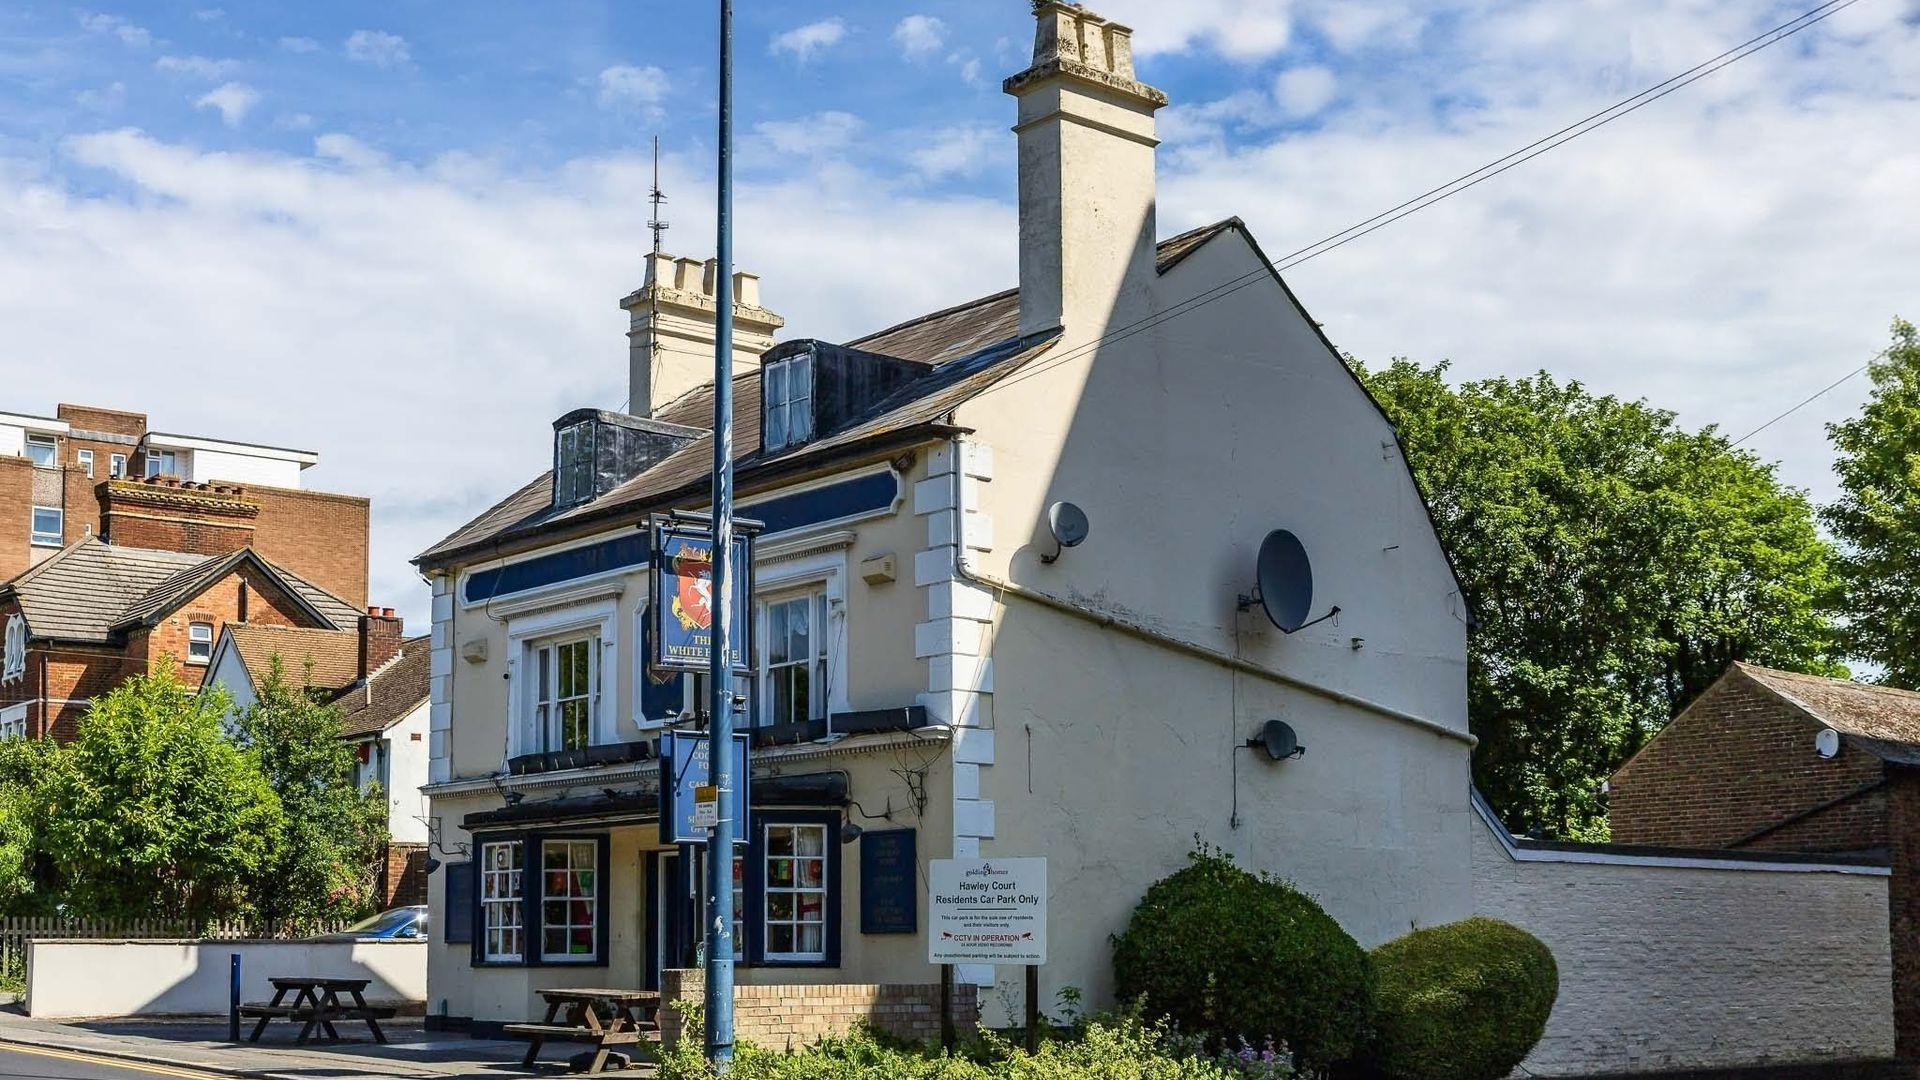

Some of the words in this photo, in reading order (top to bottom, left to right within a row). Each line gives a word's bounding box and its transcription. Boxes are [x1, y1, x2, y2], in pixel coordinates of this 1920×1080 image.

[668, 645, 704, 656] WHITE
[959, 881, 990, 892] Hawley
[991, 881, 1016, 890] Court
[935, 895, 978, 904] Residents
[979, 895, 995, 904] Car
[997, 894, 1016, 904] Park
[1018, 894, 1039, 905] Only
